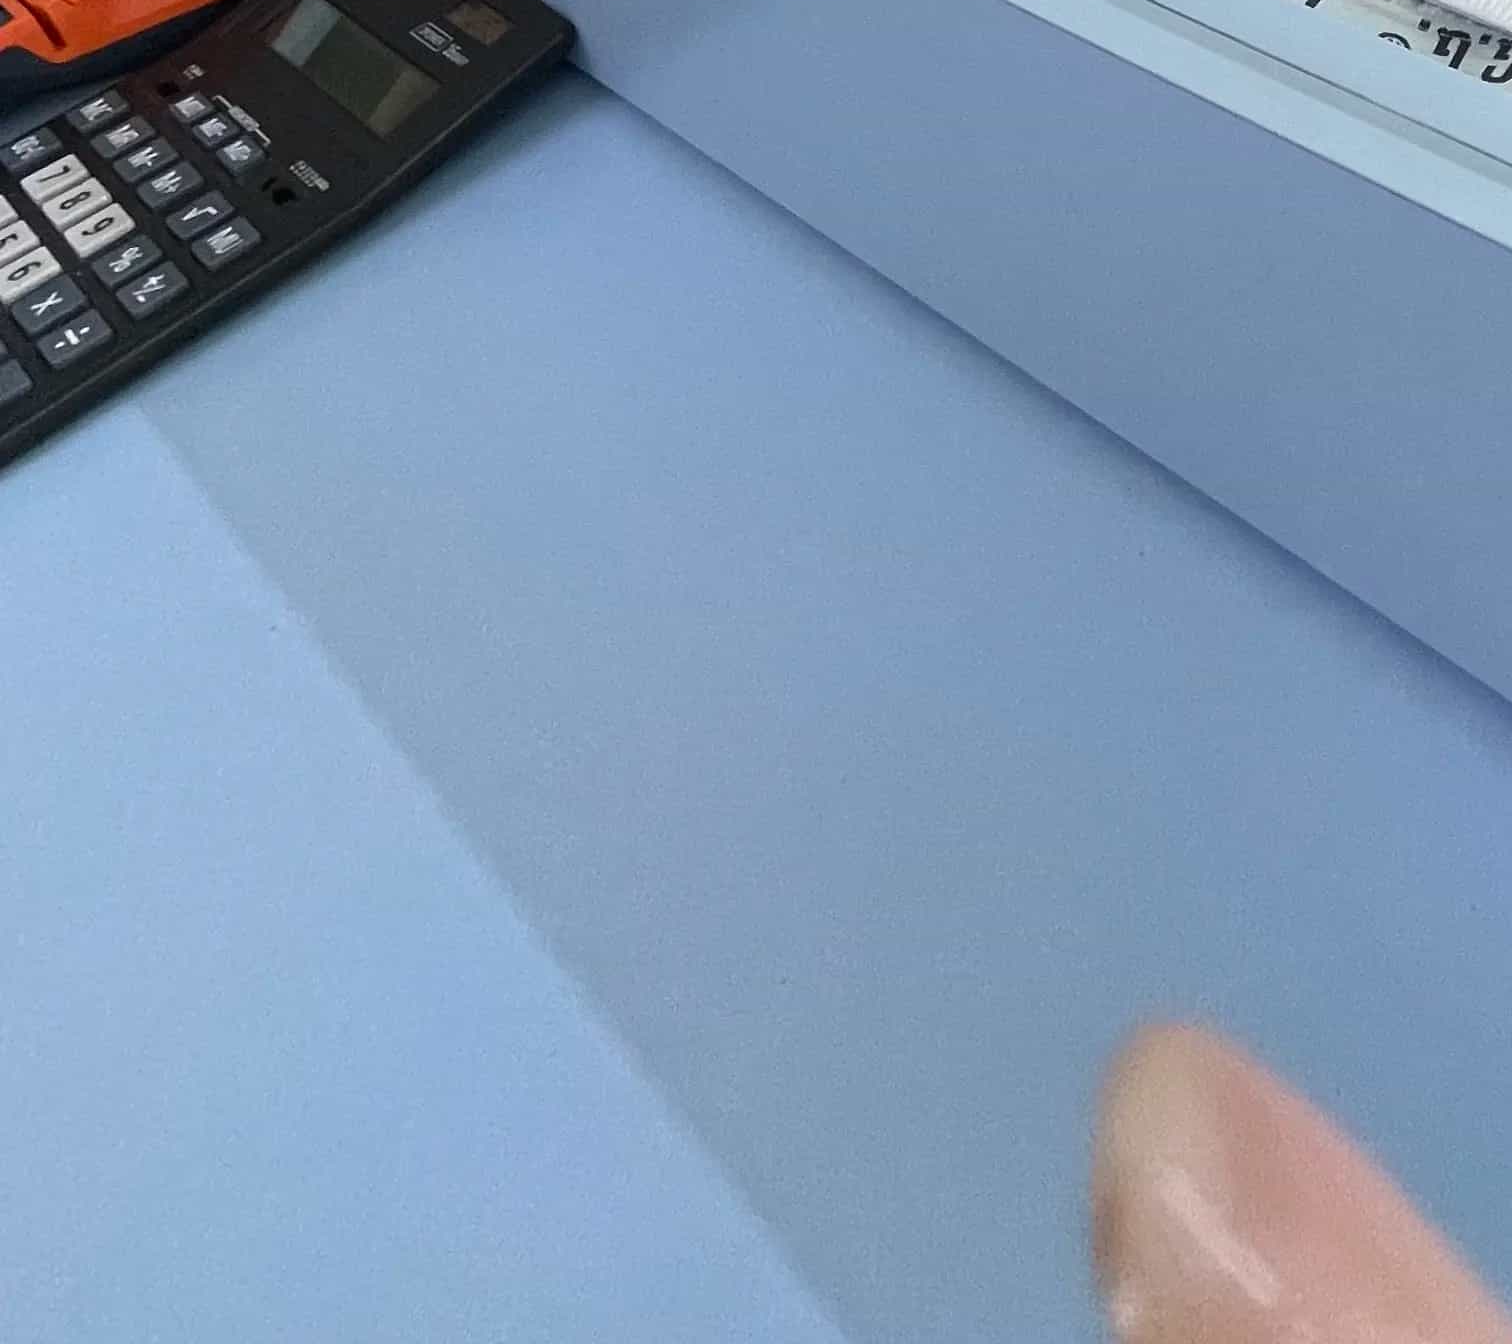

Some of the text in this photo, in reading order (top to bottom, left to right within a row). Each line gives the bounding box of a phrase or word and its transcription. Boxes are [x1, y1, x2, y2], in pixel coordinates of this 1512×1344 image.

[38, 165, 70, 183] 7
[60, 191, 91, 210] 8
[82, 217, 115, 236] 9
[7, 262, 41, 281] 6
